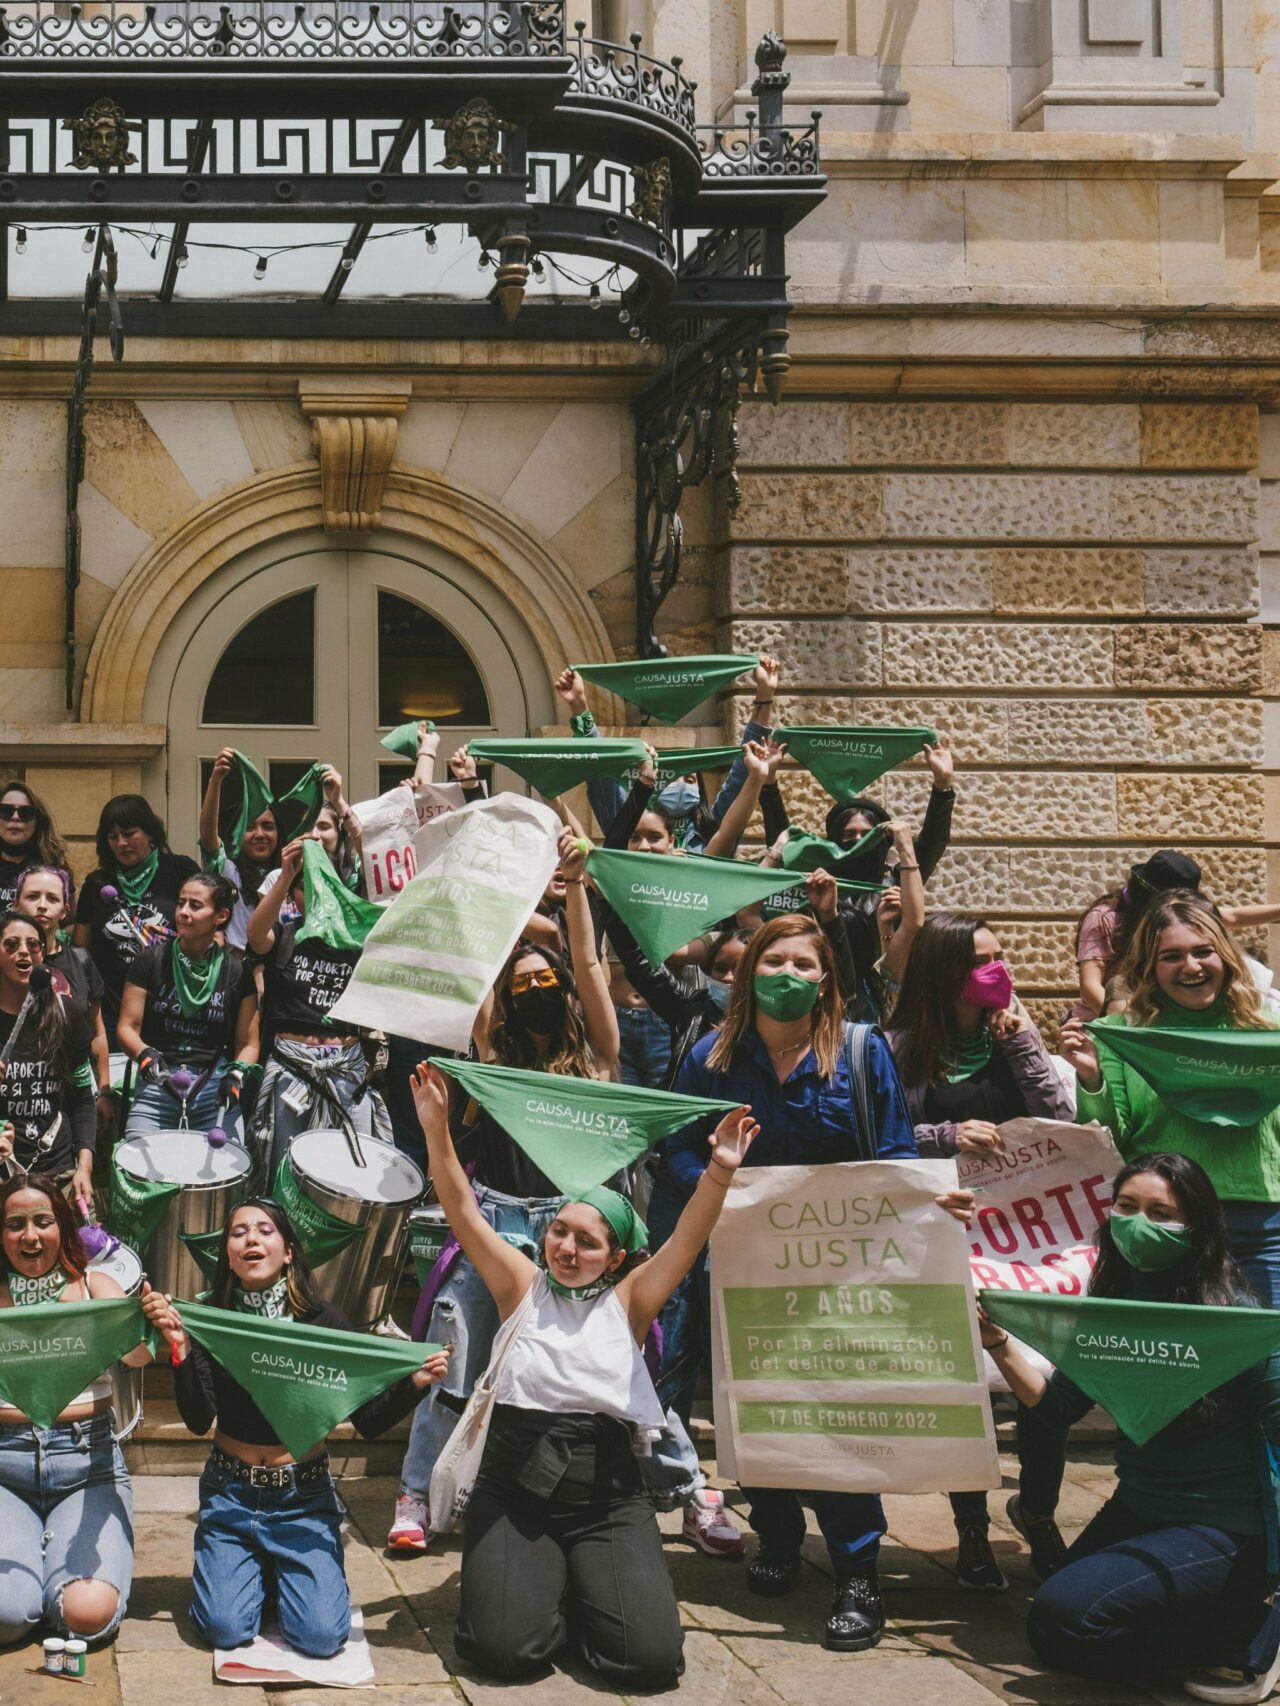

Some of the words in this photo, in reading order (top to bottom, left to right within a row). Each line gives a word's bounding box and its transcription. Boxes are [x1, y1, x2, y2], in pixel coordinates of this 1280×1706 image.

[31, 1081, 43, 1096] SE
[768, 1196, 902, 1230] CAUSA
[774, 1237, 909, 1270] JUSTA
[10, 1271, 63, 1293] ABORTO
[13, 1288, 60, 1307] LIBRE
[785, 1291, 800, 1316] 2
[818, 1285, 895, 1316] AÑOS
[747, 1336, 783, 1353] Por
[793, 1336, 812, 1352] la
[823, 1335, 953, 1354] eliminación
[750, 1355, 778, 1371] del
[789, 1355, 845, 1372] delito
[856, 1356, 878, 1372] de
[889, 1356, 956, 1374] aborto
[769, 1409, 786, 1426] 17
[793, 1409, 812, 1426] DE
[817, 1409, 889, 1428] FEBRERO
[895, 1412, 938, 1429] 2022
